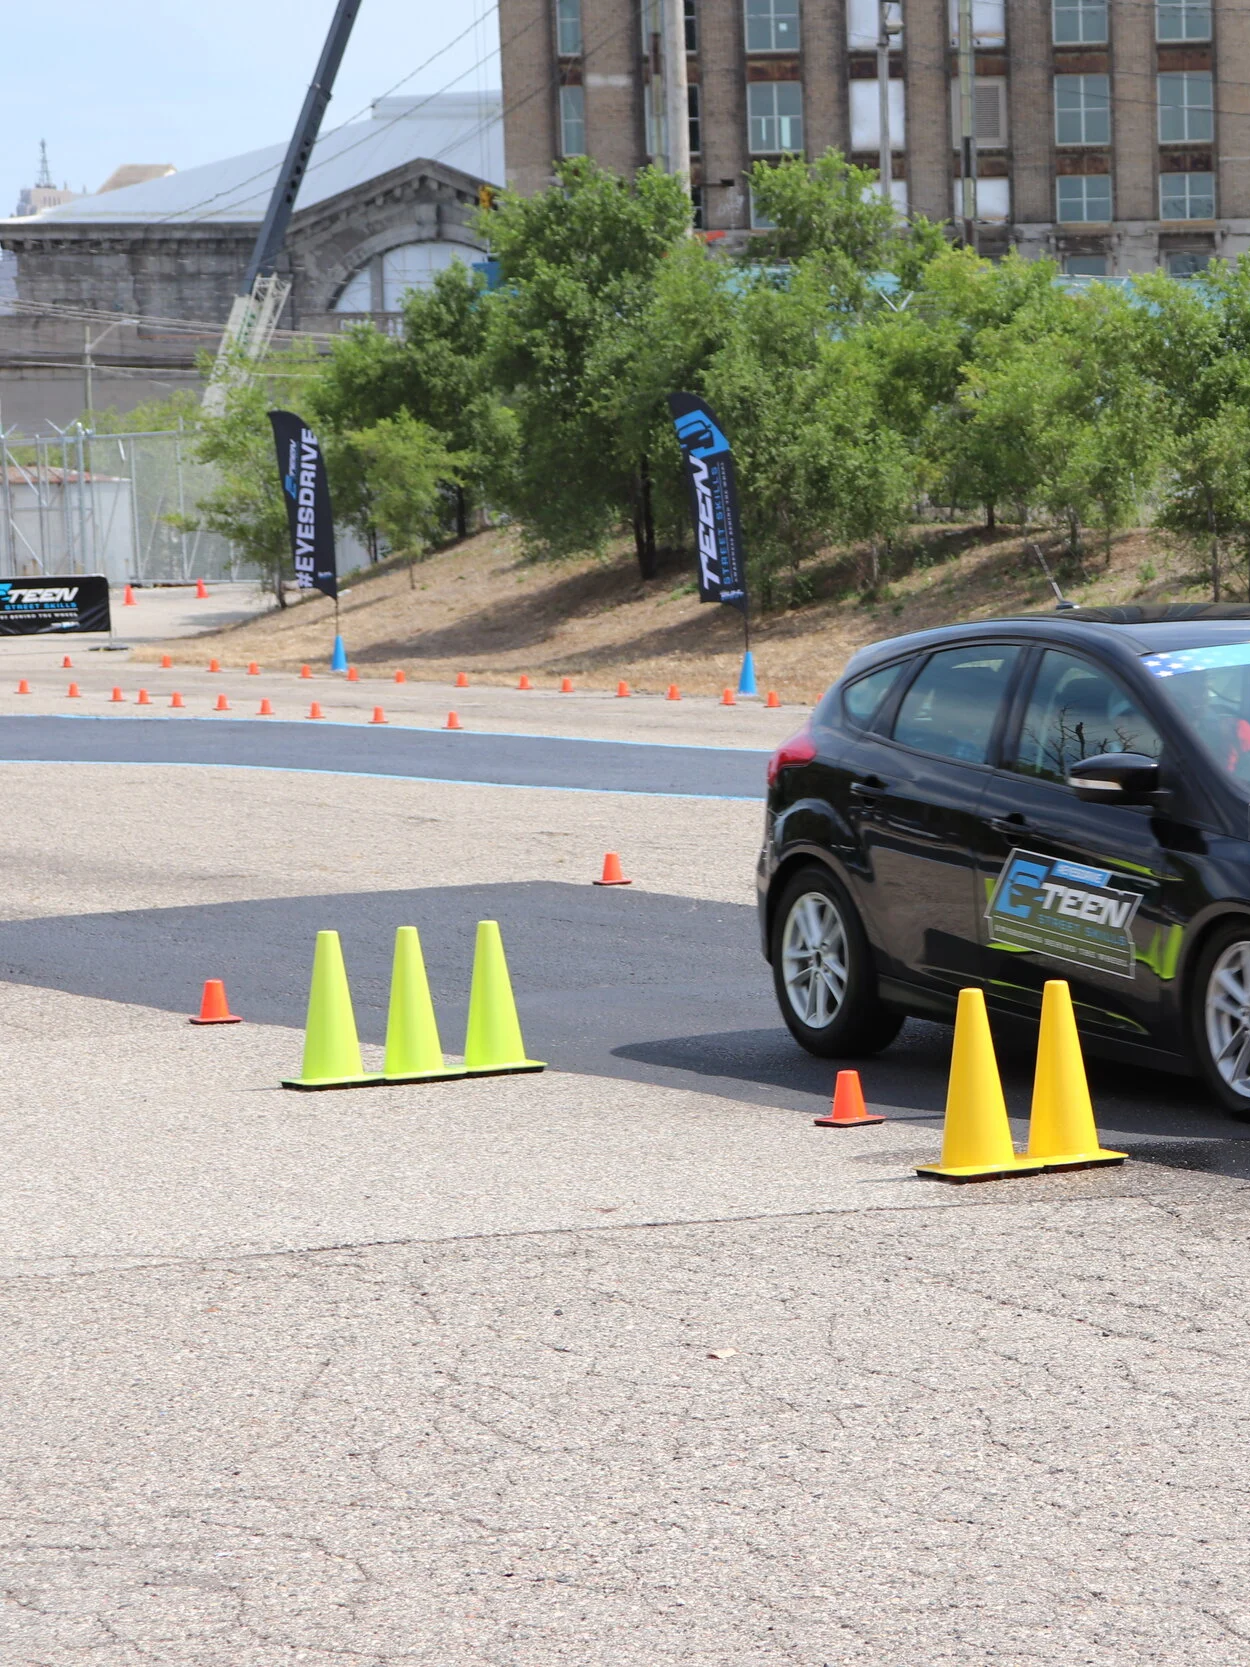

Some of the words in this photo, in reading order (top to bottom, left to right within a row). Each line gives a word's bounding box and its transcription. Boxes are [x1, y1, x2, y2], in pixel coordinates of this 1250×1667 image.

[295, 428, 319, 589] #EYESDRIVE
[711, 467, 724, 520] SKILLS
[717, 528, 733, 584] STREET
[1037, 914, 1080, 933] STREET
